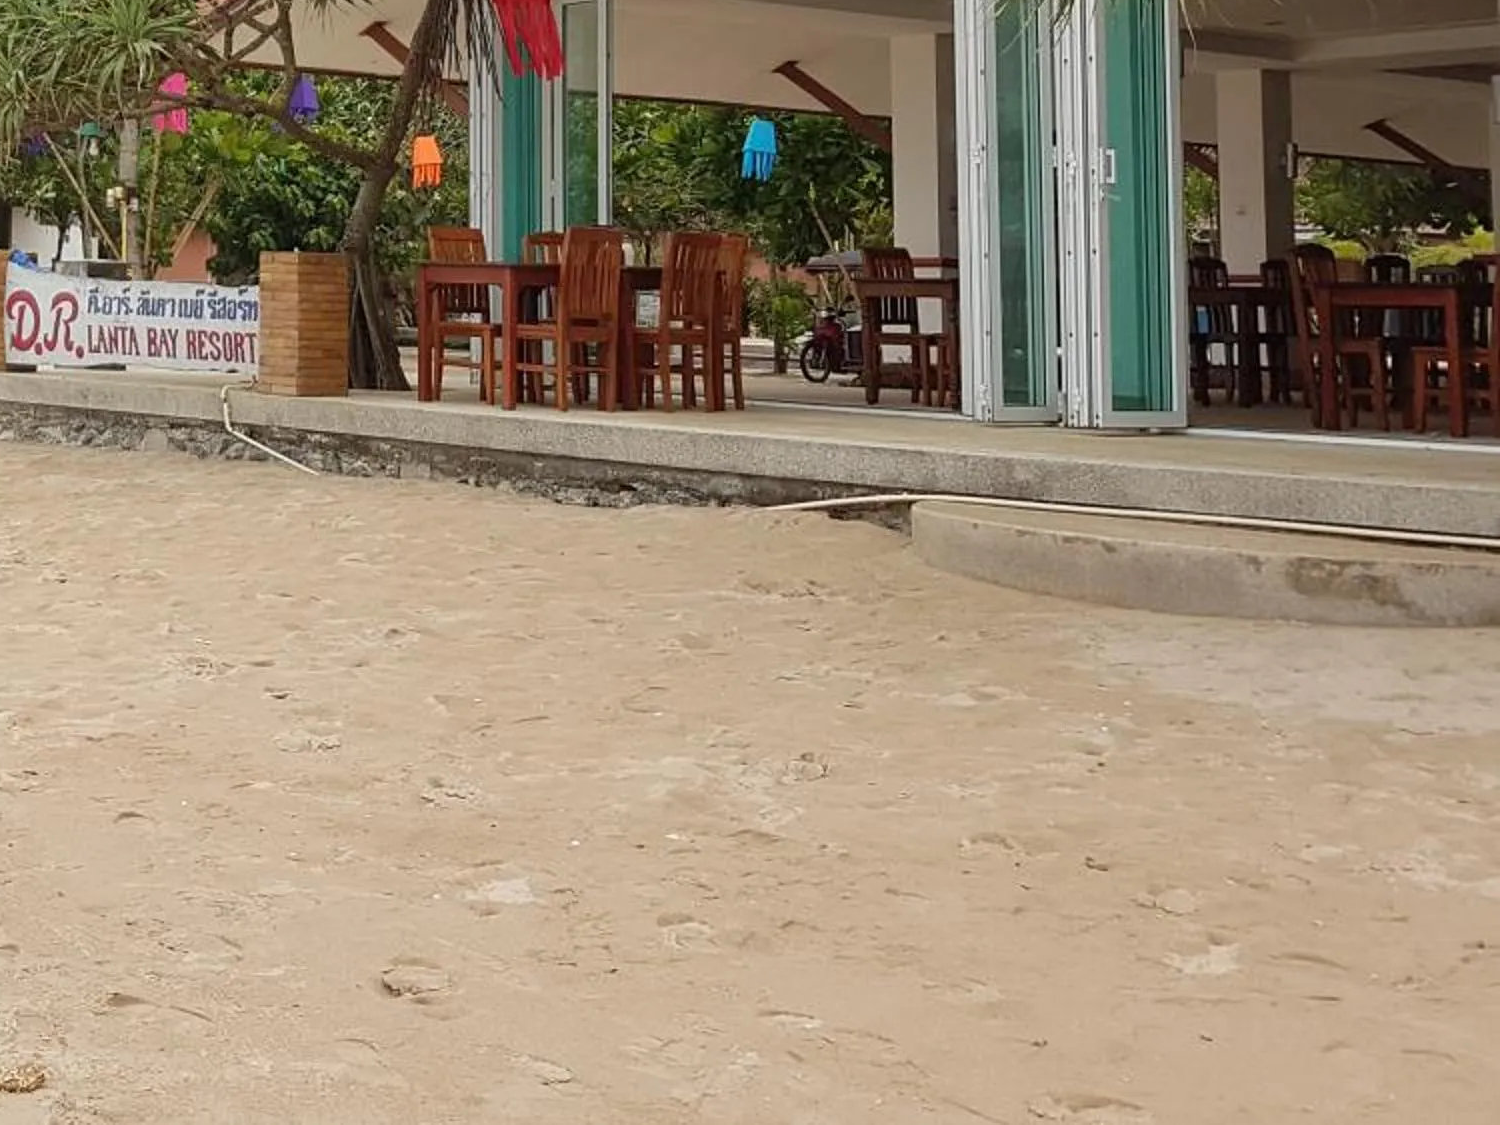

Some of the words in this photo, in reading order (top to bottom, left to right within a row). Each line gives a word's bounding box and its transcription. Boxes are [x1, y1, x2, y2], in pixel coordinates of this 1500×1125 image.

[6, 289, 85, 359] D.R.
[87, 324, 140, 356] LANTA
[147, 327, 179, 359] BAY
[186, 329, 257, 363] RESORT
